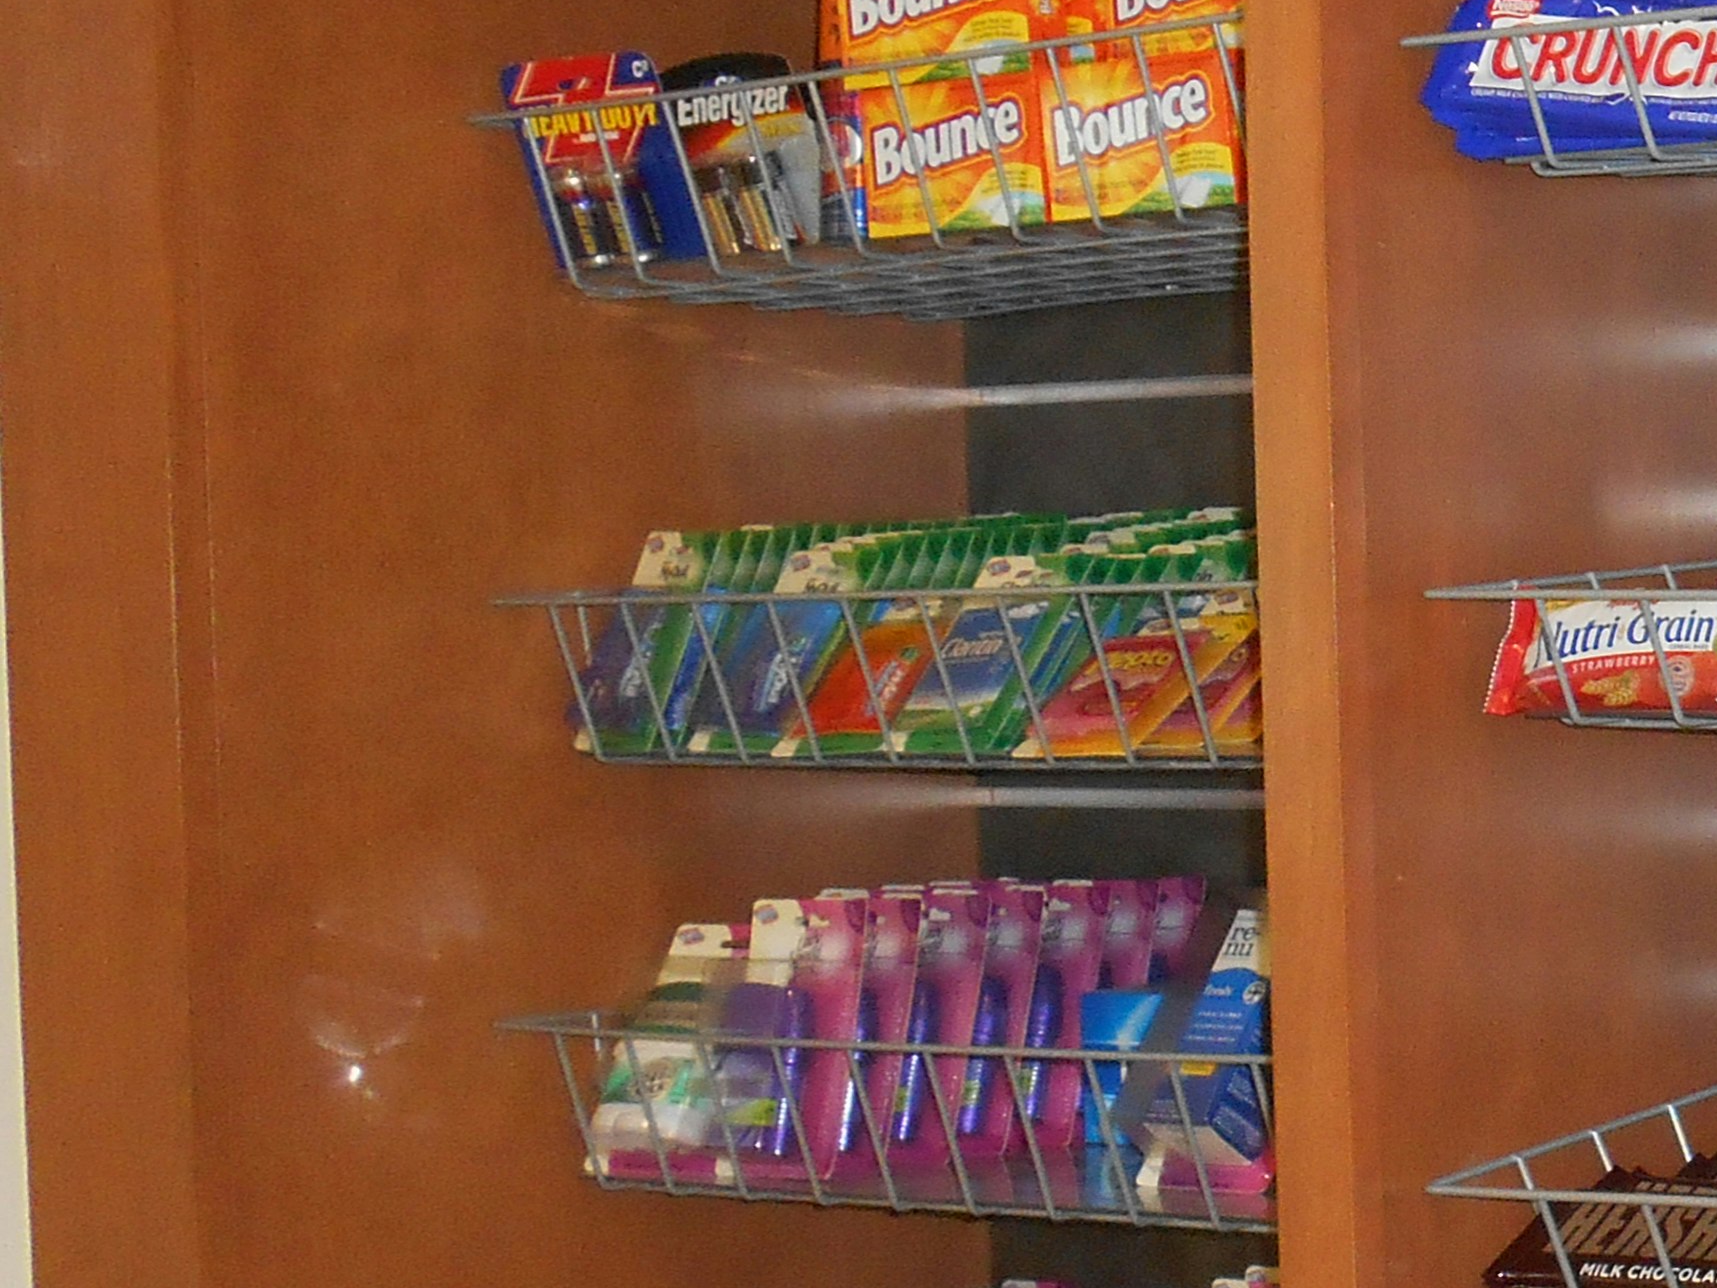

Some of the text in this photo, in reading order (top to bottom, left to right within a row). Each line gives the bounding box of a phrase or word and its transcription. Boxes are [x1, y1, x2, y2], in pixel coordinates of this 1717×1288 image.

[872, 94, 1020, 185] Bounce
[1052, 78, 1207, 165] Bounce
[1626, 609, 1715, 651] Grain
[1571, 654, 1656, 673] STRAWBERRY
[1579, 1262, 1624, 1279] MILK
